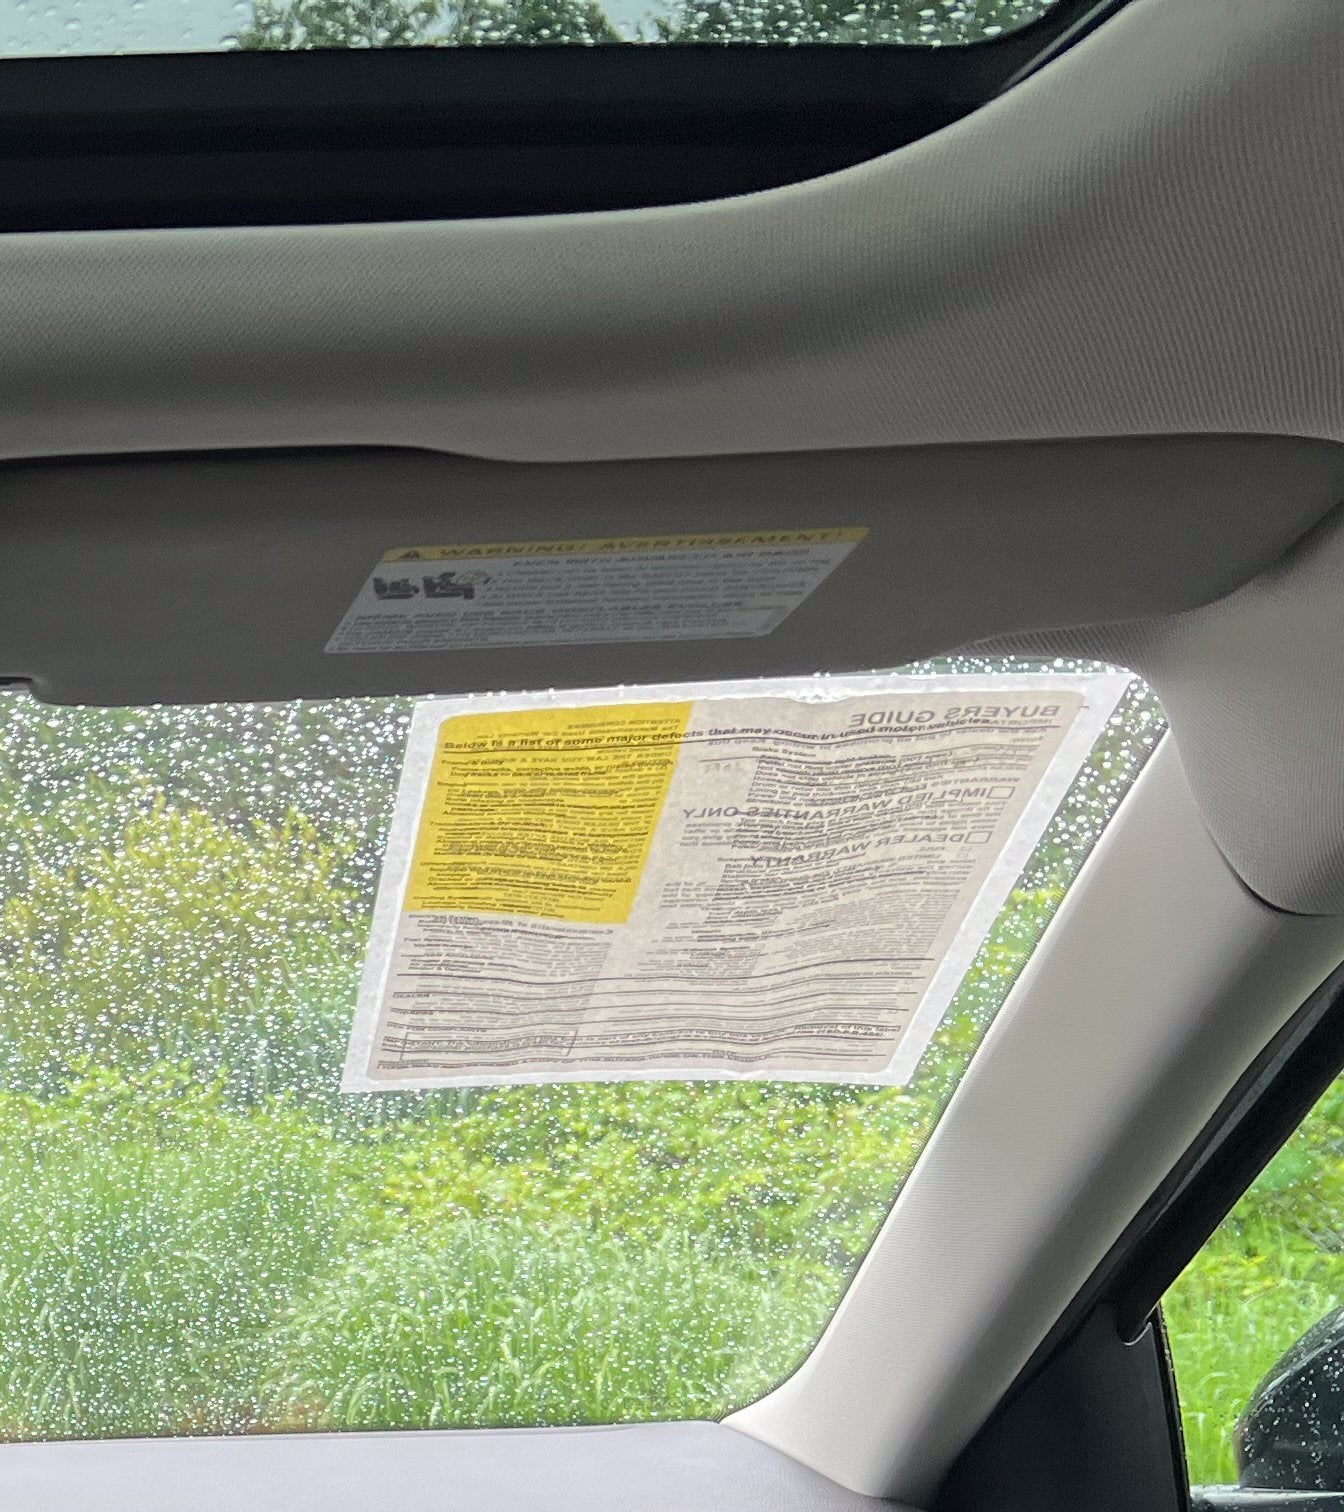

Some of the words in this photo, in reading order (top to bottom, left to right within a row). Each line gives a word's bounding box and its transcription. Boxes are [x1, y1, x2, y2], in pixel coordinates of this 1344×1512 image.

[444, 740, 488, 749] Below
[564, 738, 602, 746] some
[606, 735, 648, 744] major
[651, 730, 704, 742] defects
